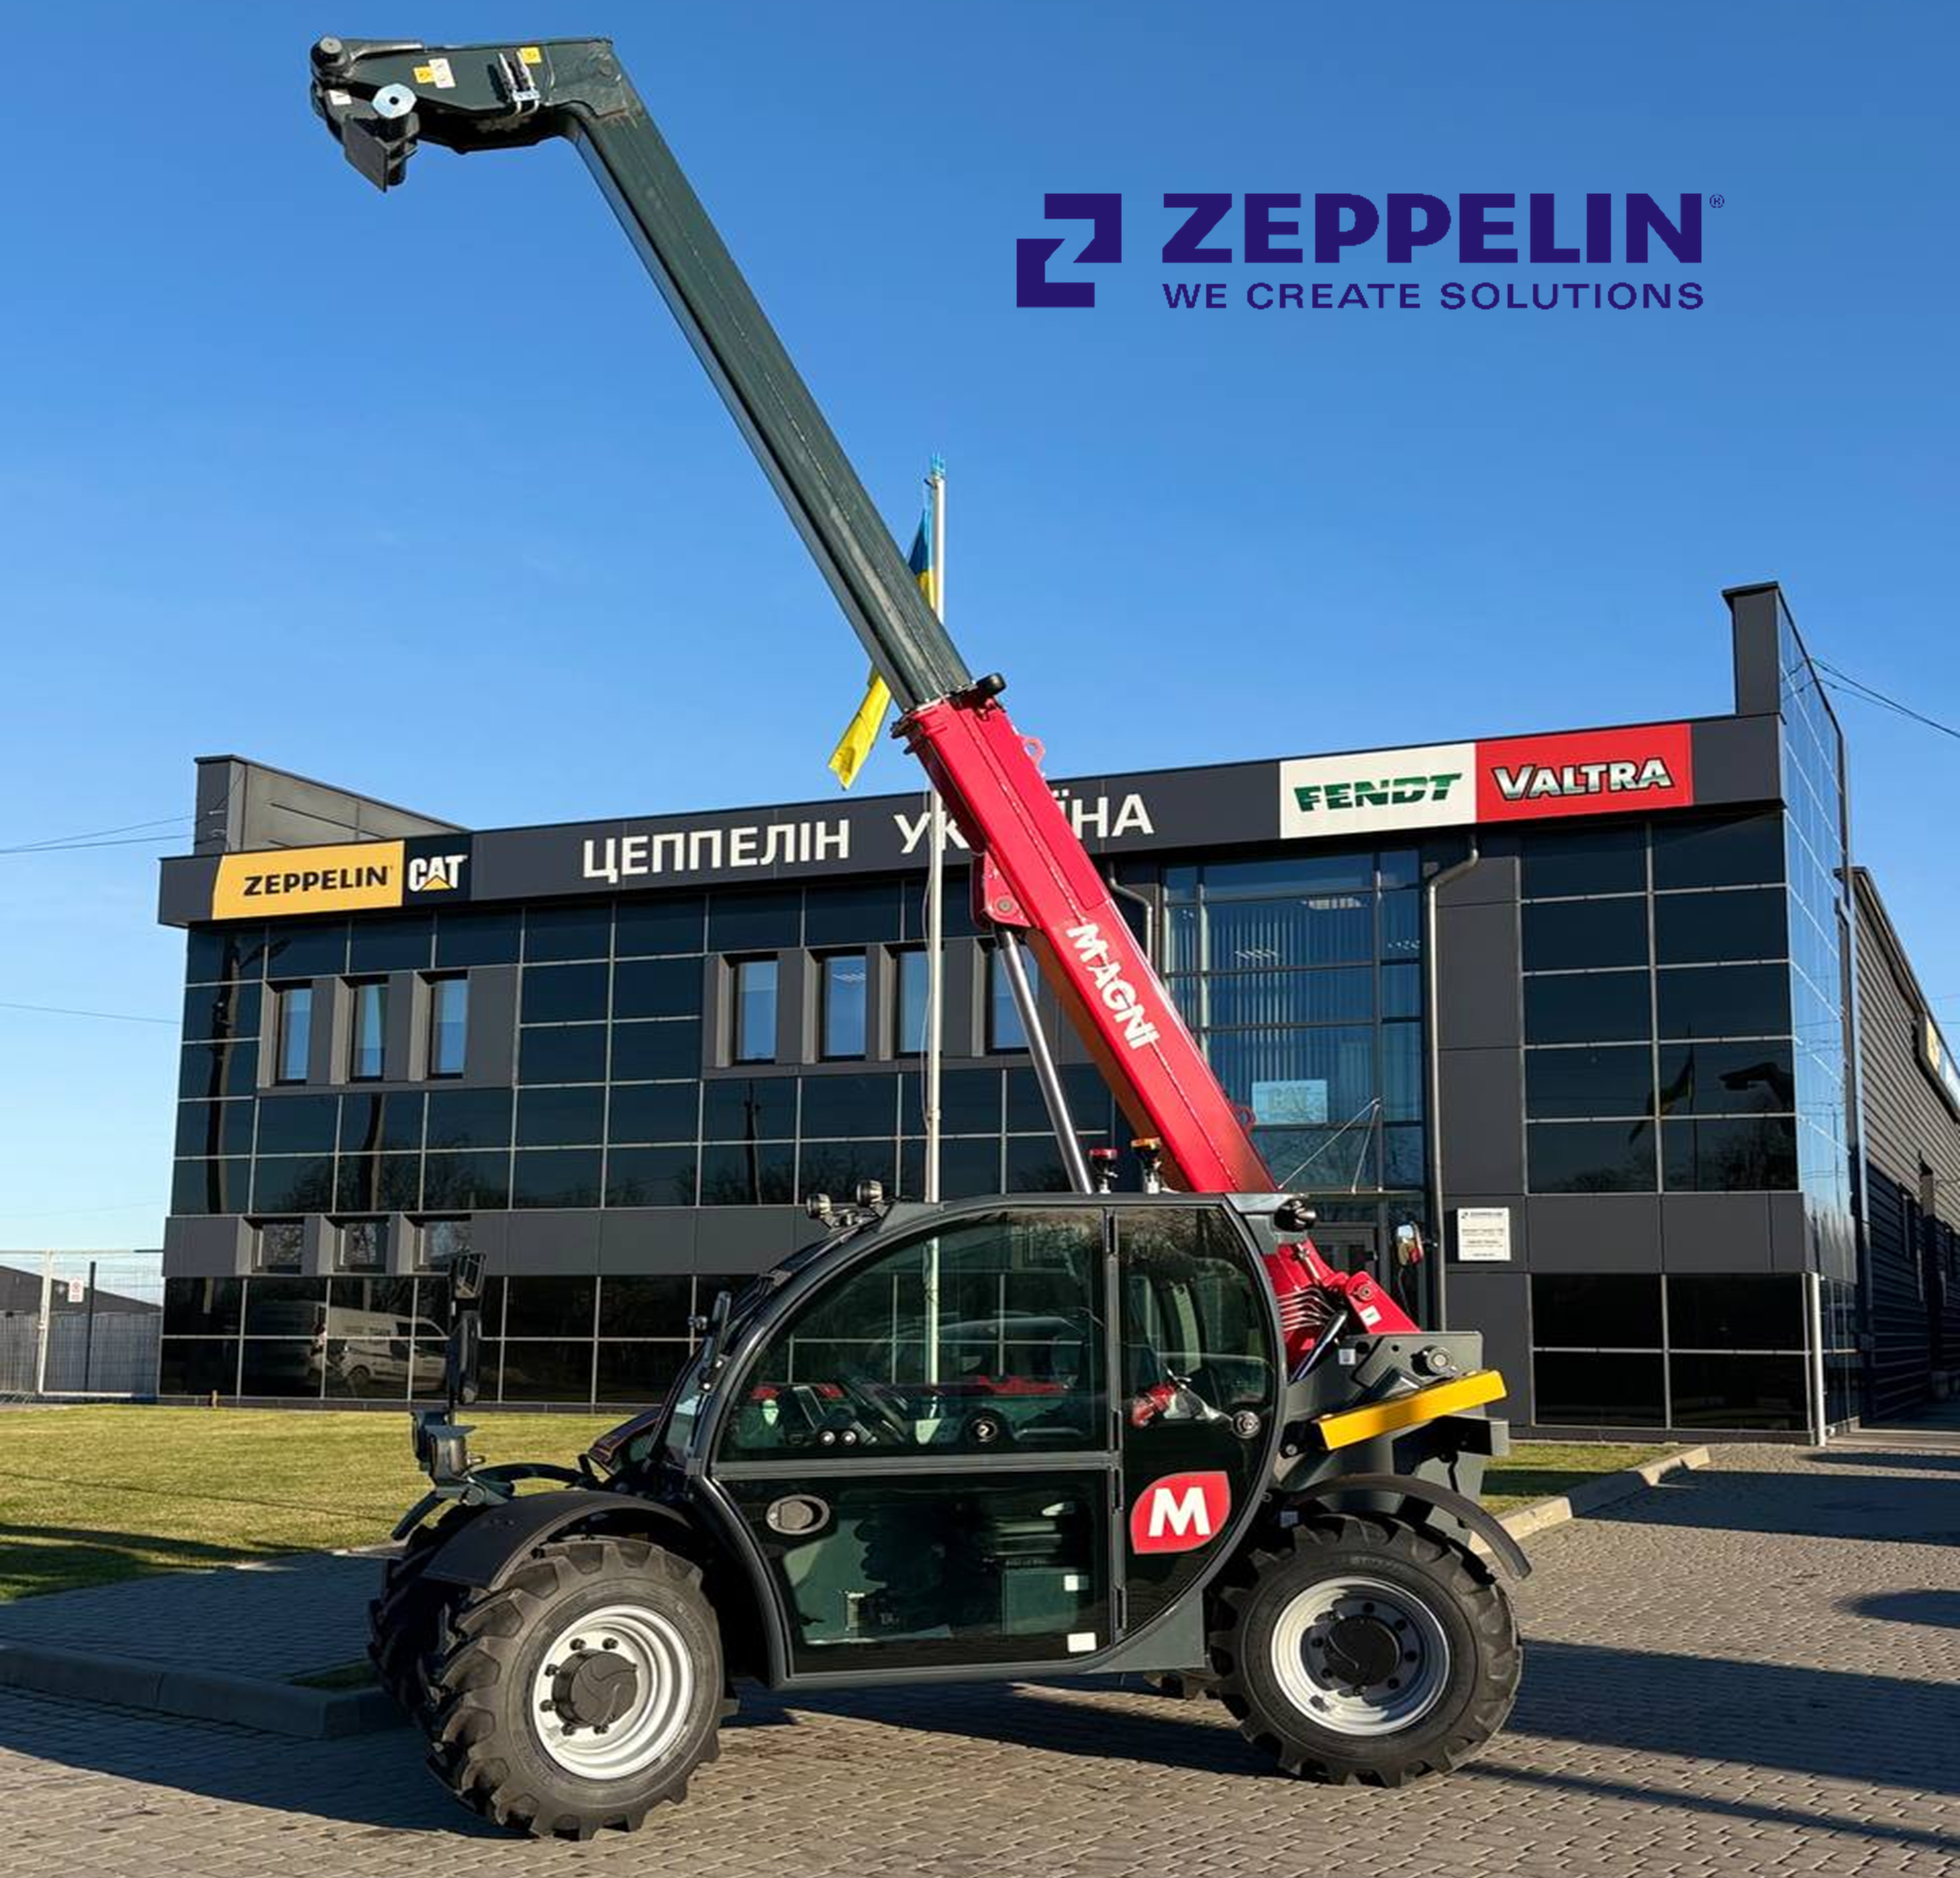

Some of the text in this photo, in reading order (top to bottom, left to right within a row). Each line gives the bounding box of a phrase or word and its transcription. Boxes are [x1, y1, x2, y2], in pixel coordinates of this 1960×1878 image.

[1293, 773, 1462, 812] FENDT
[1492, 758, 1675, 801] VALTRA
[582, 789, 1155, 883] ЦЕППЕЛІН УКЇНА
[243, 866, 388, 896] ZEPPELIN
[408, 854, 468, 892] CAT
[1066, 923, 1160, 1049] MAGNI
[1148, 1486, 1211, 1537] M
